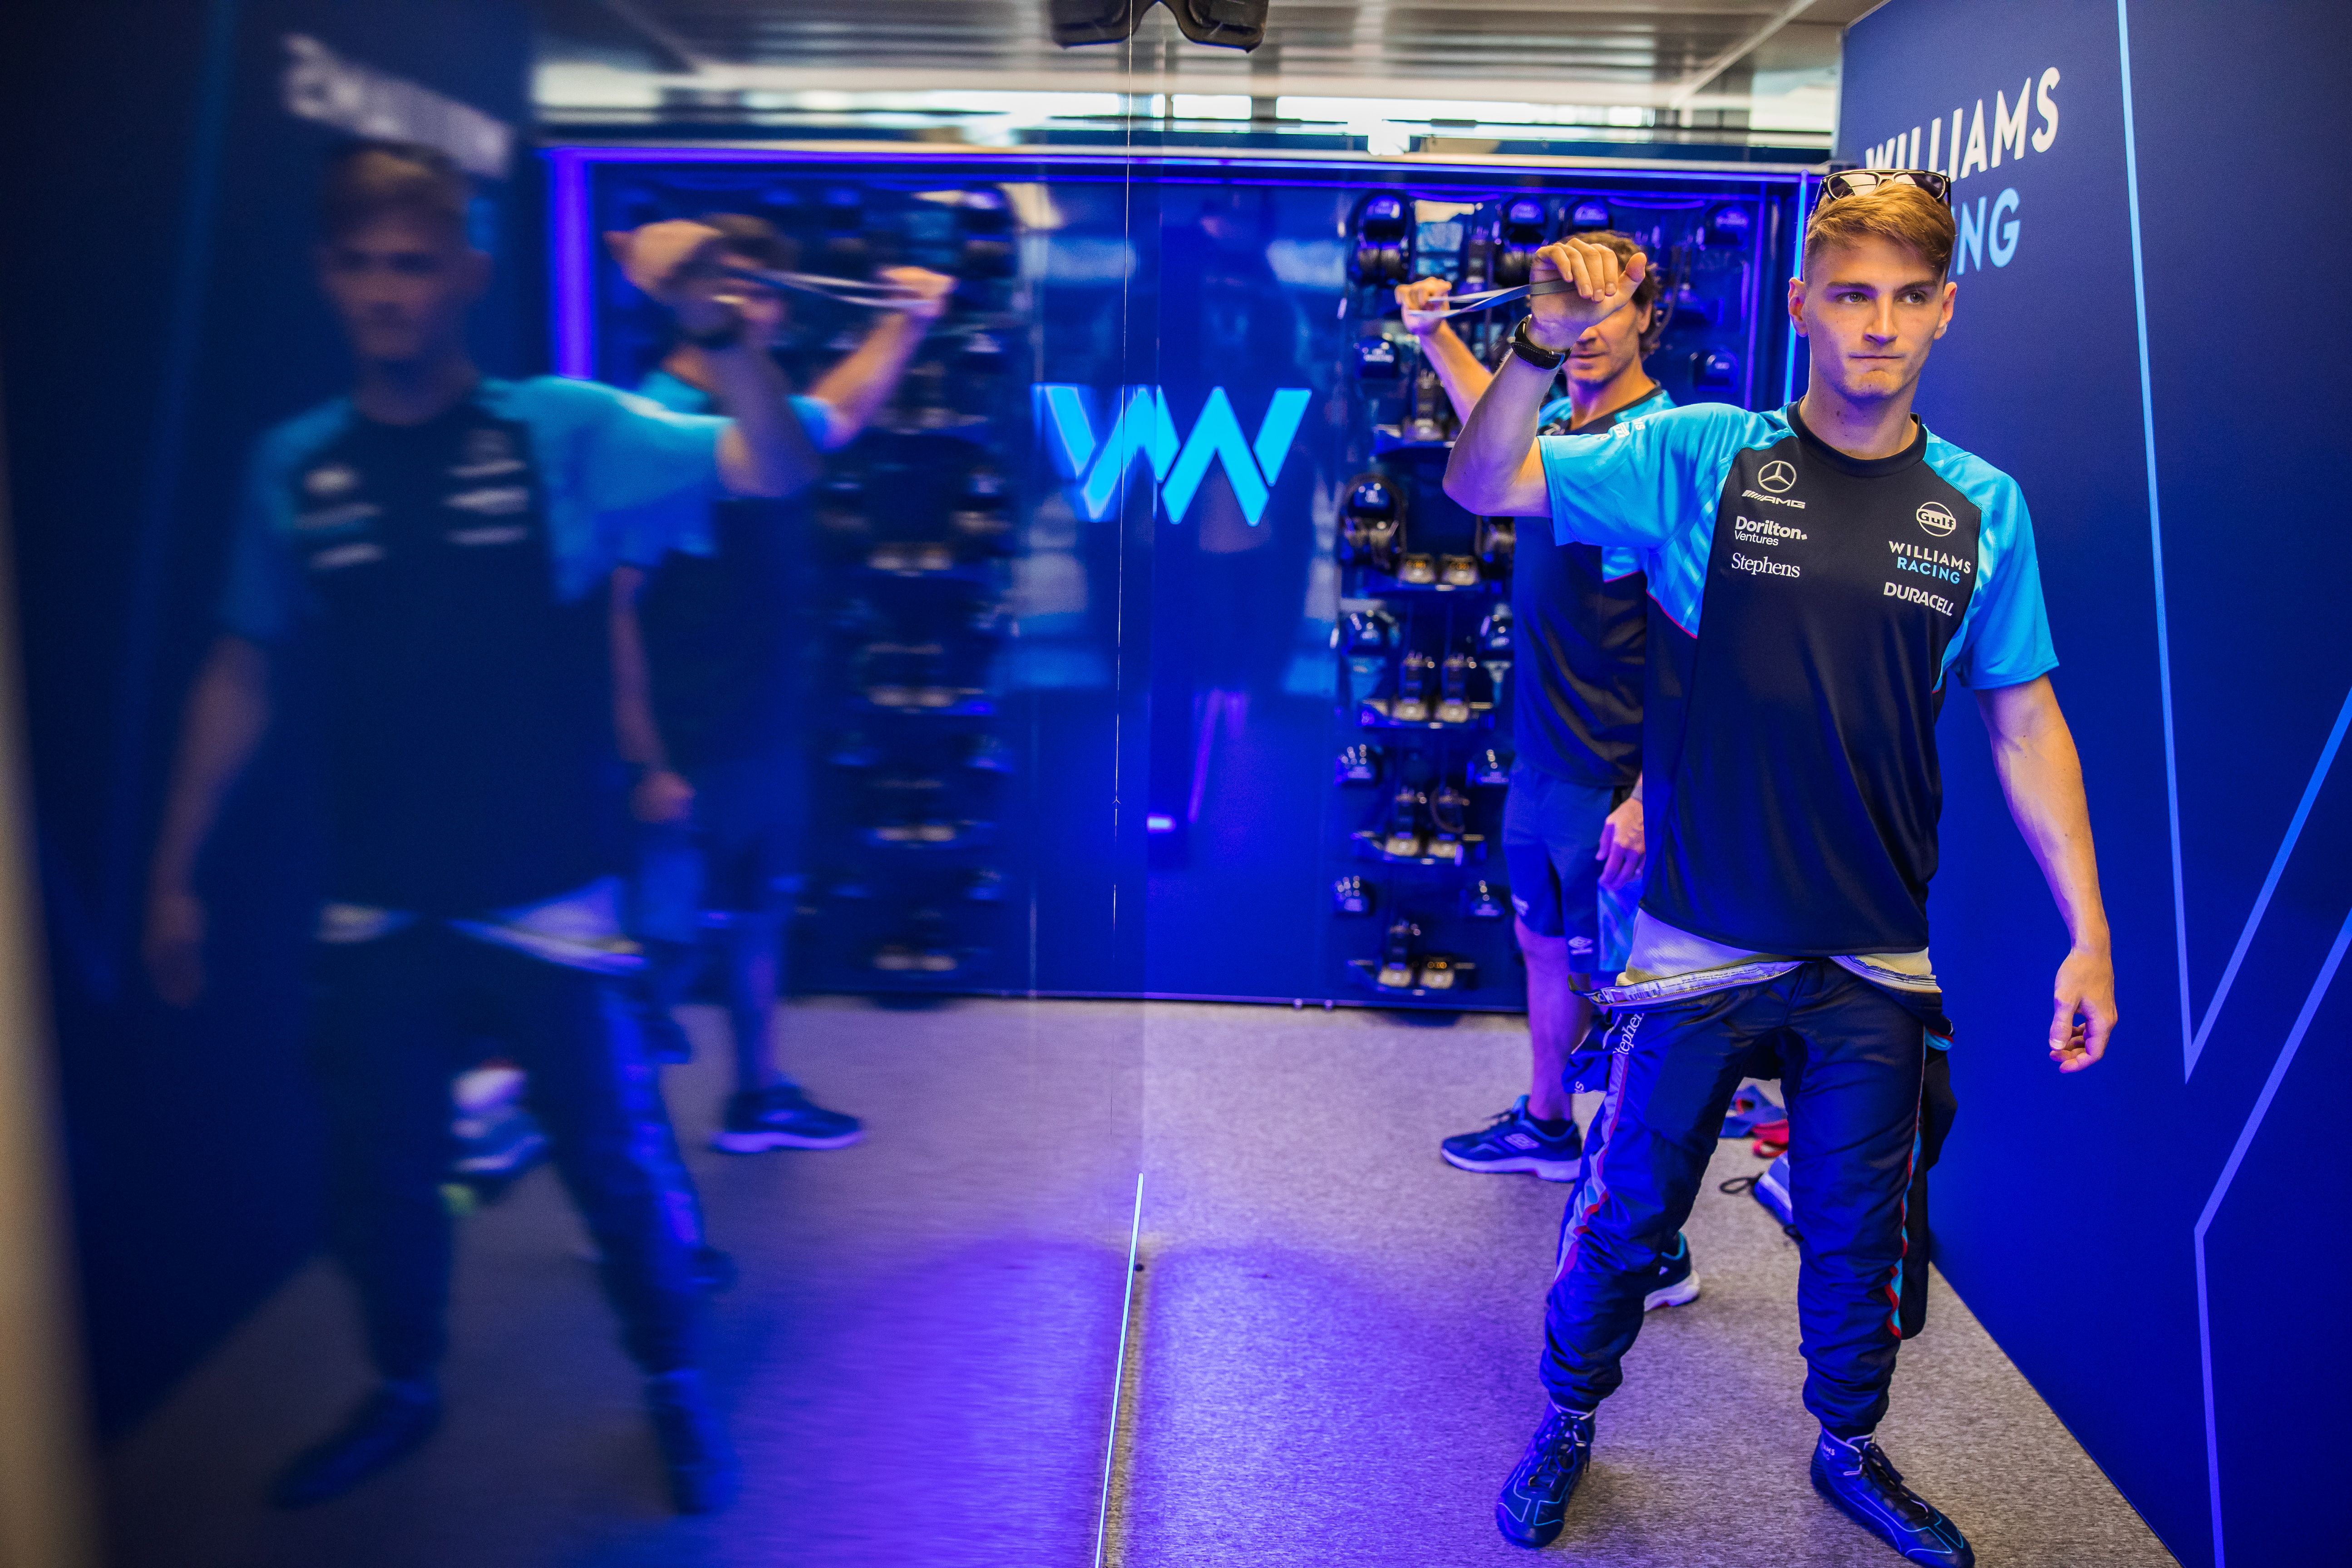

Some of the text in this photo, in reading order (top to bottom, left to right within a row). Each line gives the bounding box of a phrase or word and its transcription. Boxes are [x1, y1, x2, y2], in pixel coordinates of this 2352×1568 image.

[1918, 511, 1954, 528] Gulf
[1735, 530, 1779, 546] Ventures
[1731, 552, 1800, 577] Stephens
[1889, 541, 1972, 574] WILLIAMS
[1897, 557, 1960, 584] RACING
[1883, 582, 1954, 616] DURACELL
